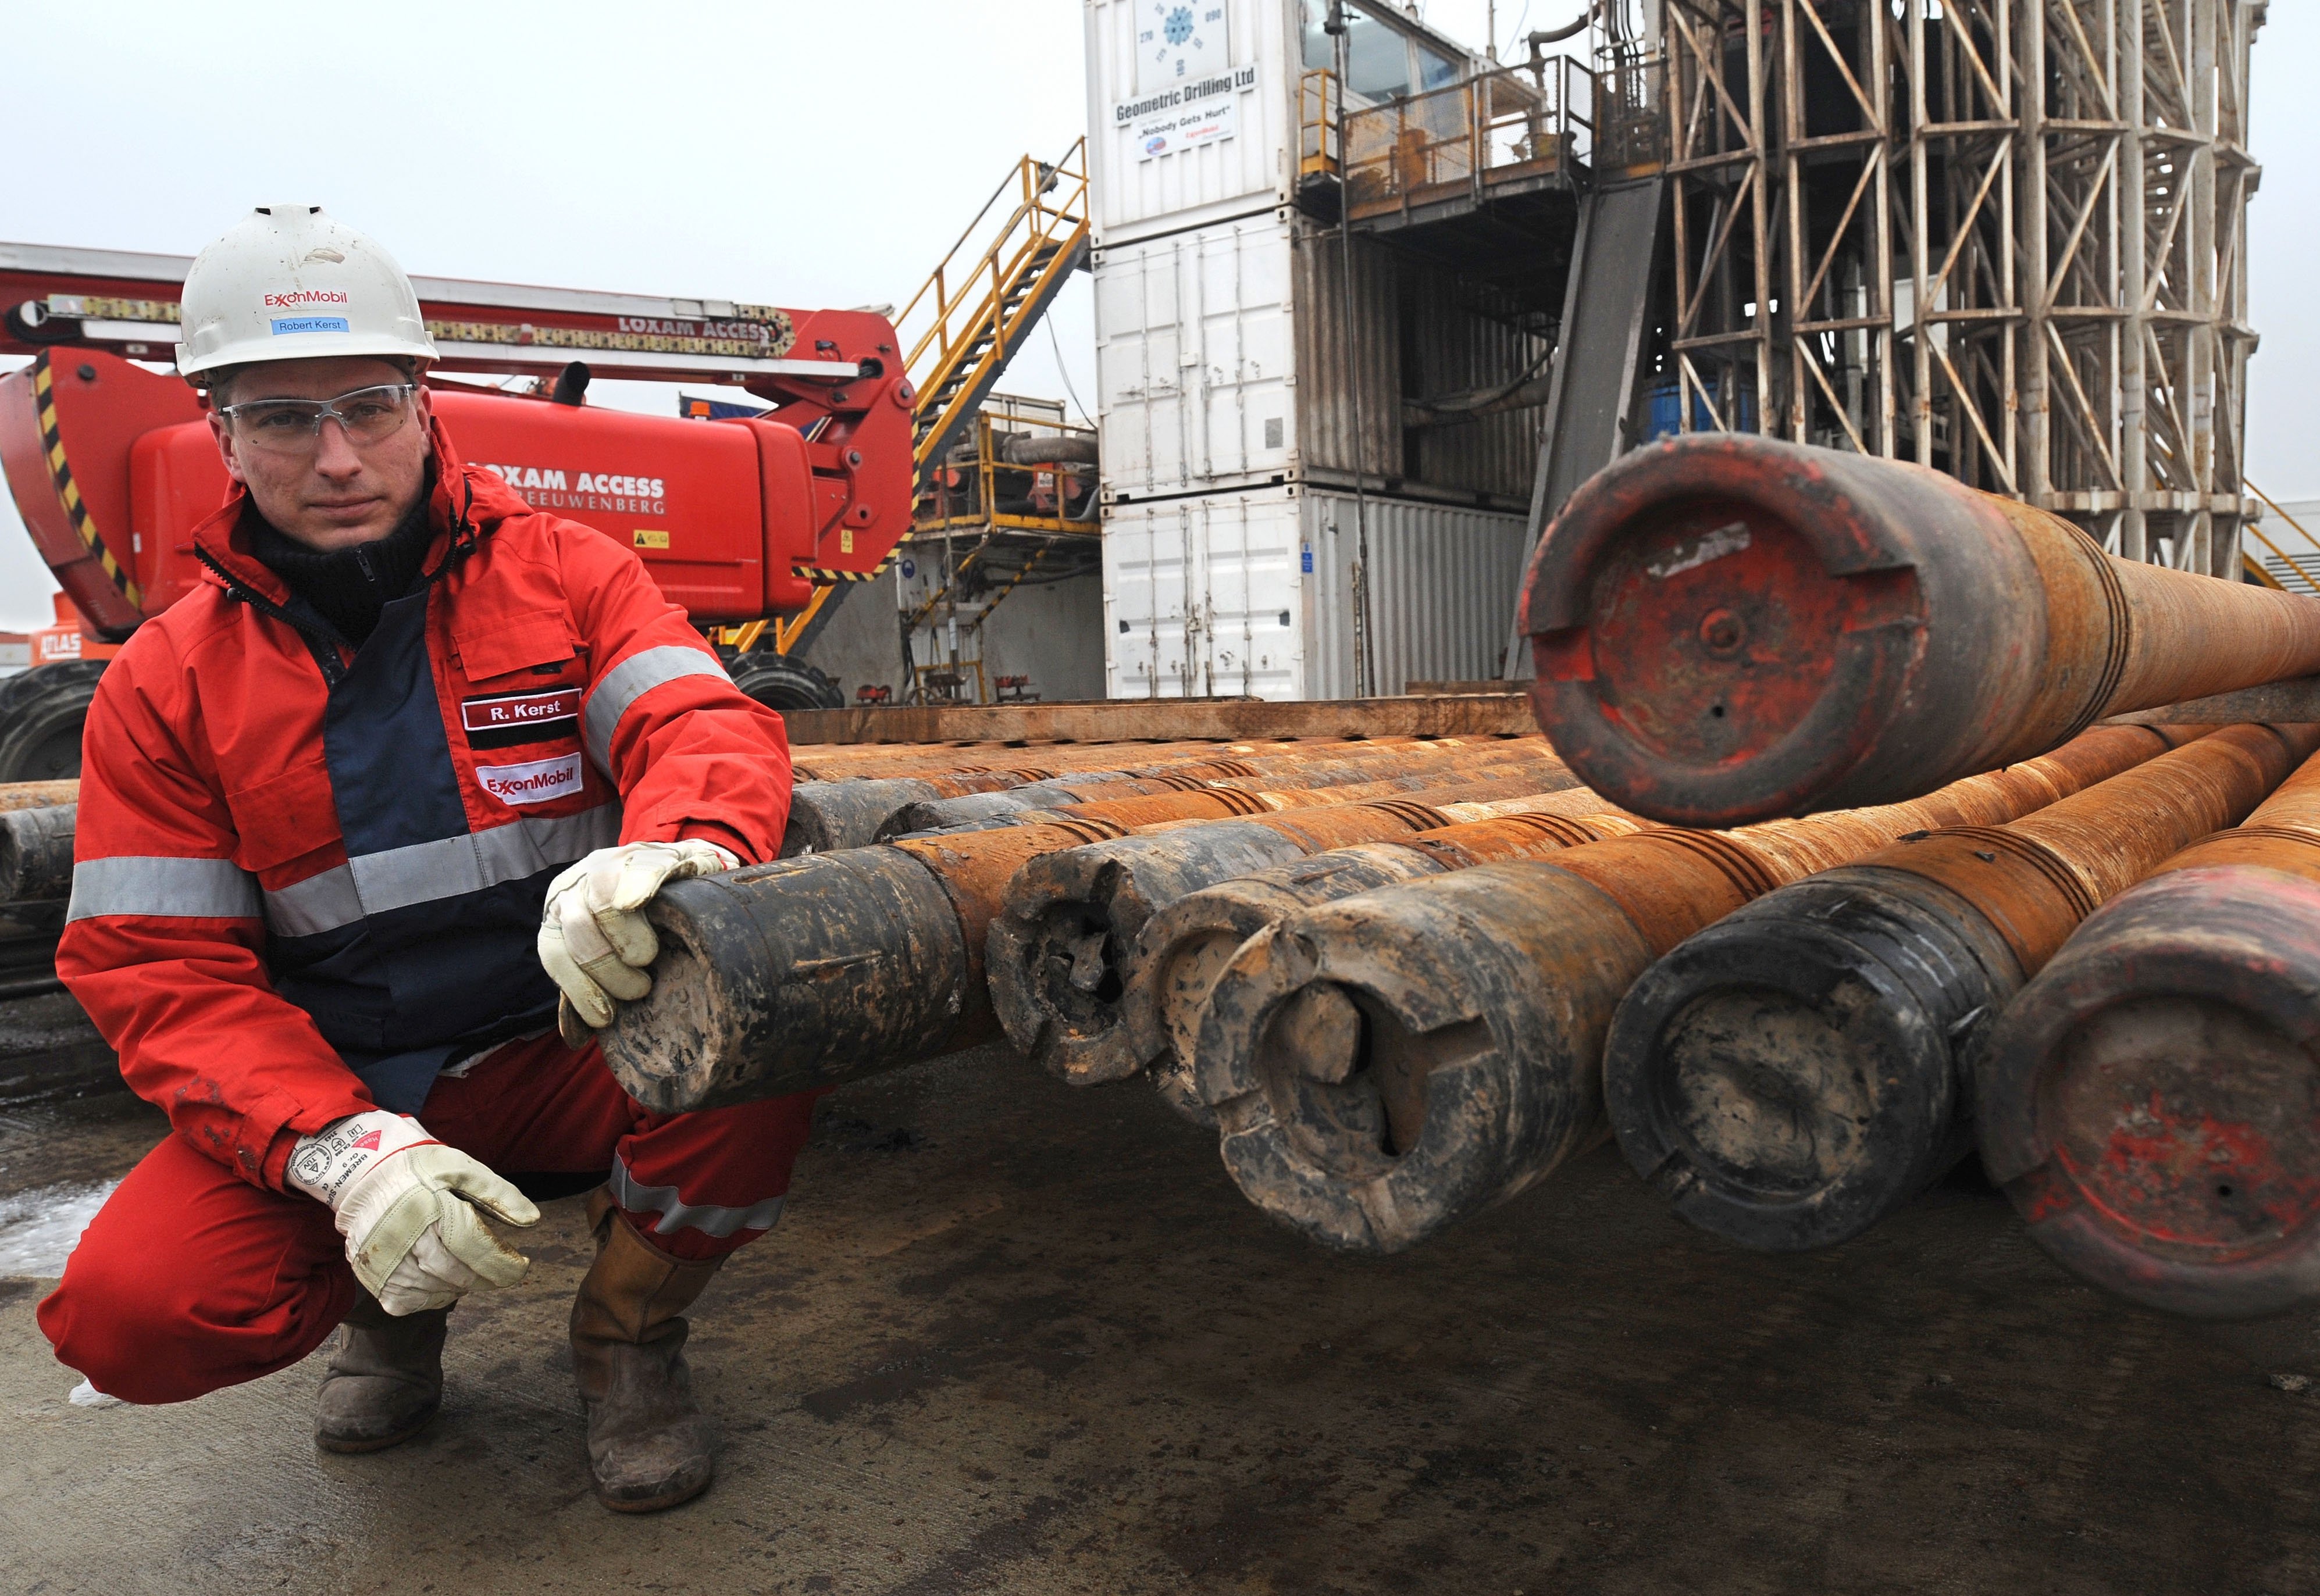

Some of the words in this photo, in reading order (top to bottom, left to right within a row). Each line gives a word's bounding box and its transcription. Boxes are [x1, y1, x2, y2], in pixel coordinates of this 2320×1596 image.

[1117, 91, 1181, 121] Geometric
[1184, 76, 1232, 102] Drilling
[1235, 67, 1254, 87] Ltd
[1179, 115, 1201, 127] Gets
[264, 291, 348, 307] ExxonMobil
[279, 321, 313, 331] Robert
[315, 320, 341, 329] Kerst
[618, 316, 696, 337] LOXAM
[703, 322, 769, 341] ACCESS
[468, 462, 568, 491] XAM
[576, 472, 665, 498] ACCESS
[490, 707, 510, 721] R.
[514, 701, 561, 718] Kerst
[487, 767, 573, 795] ExxonMobil
[325, 1130, 338, 1142] 3143
[359, 1137, 379, 1147] Hase
[304, 1157, 317, 1170] TÜV
[347, 1152, 359, 1162] Gr.
